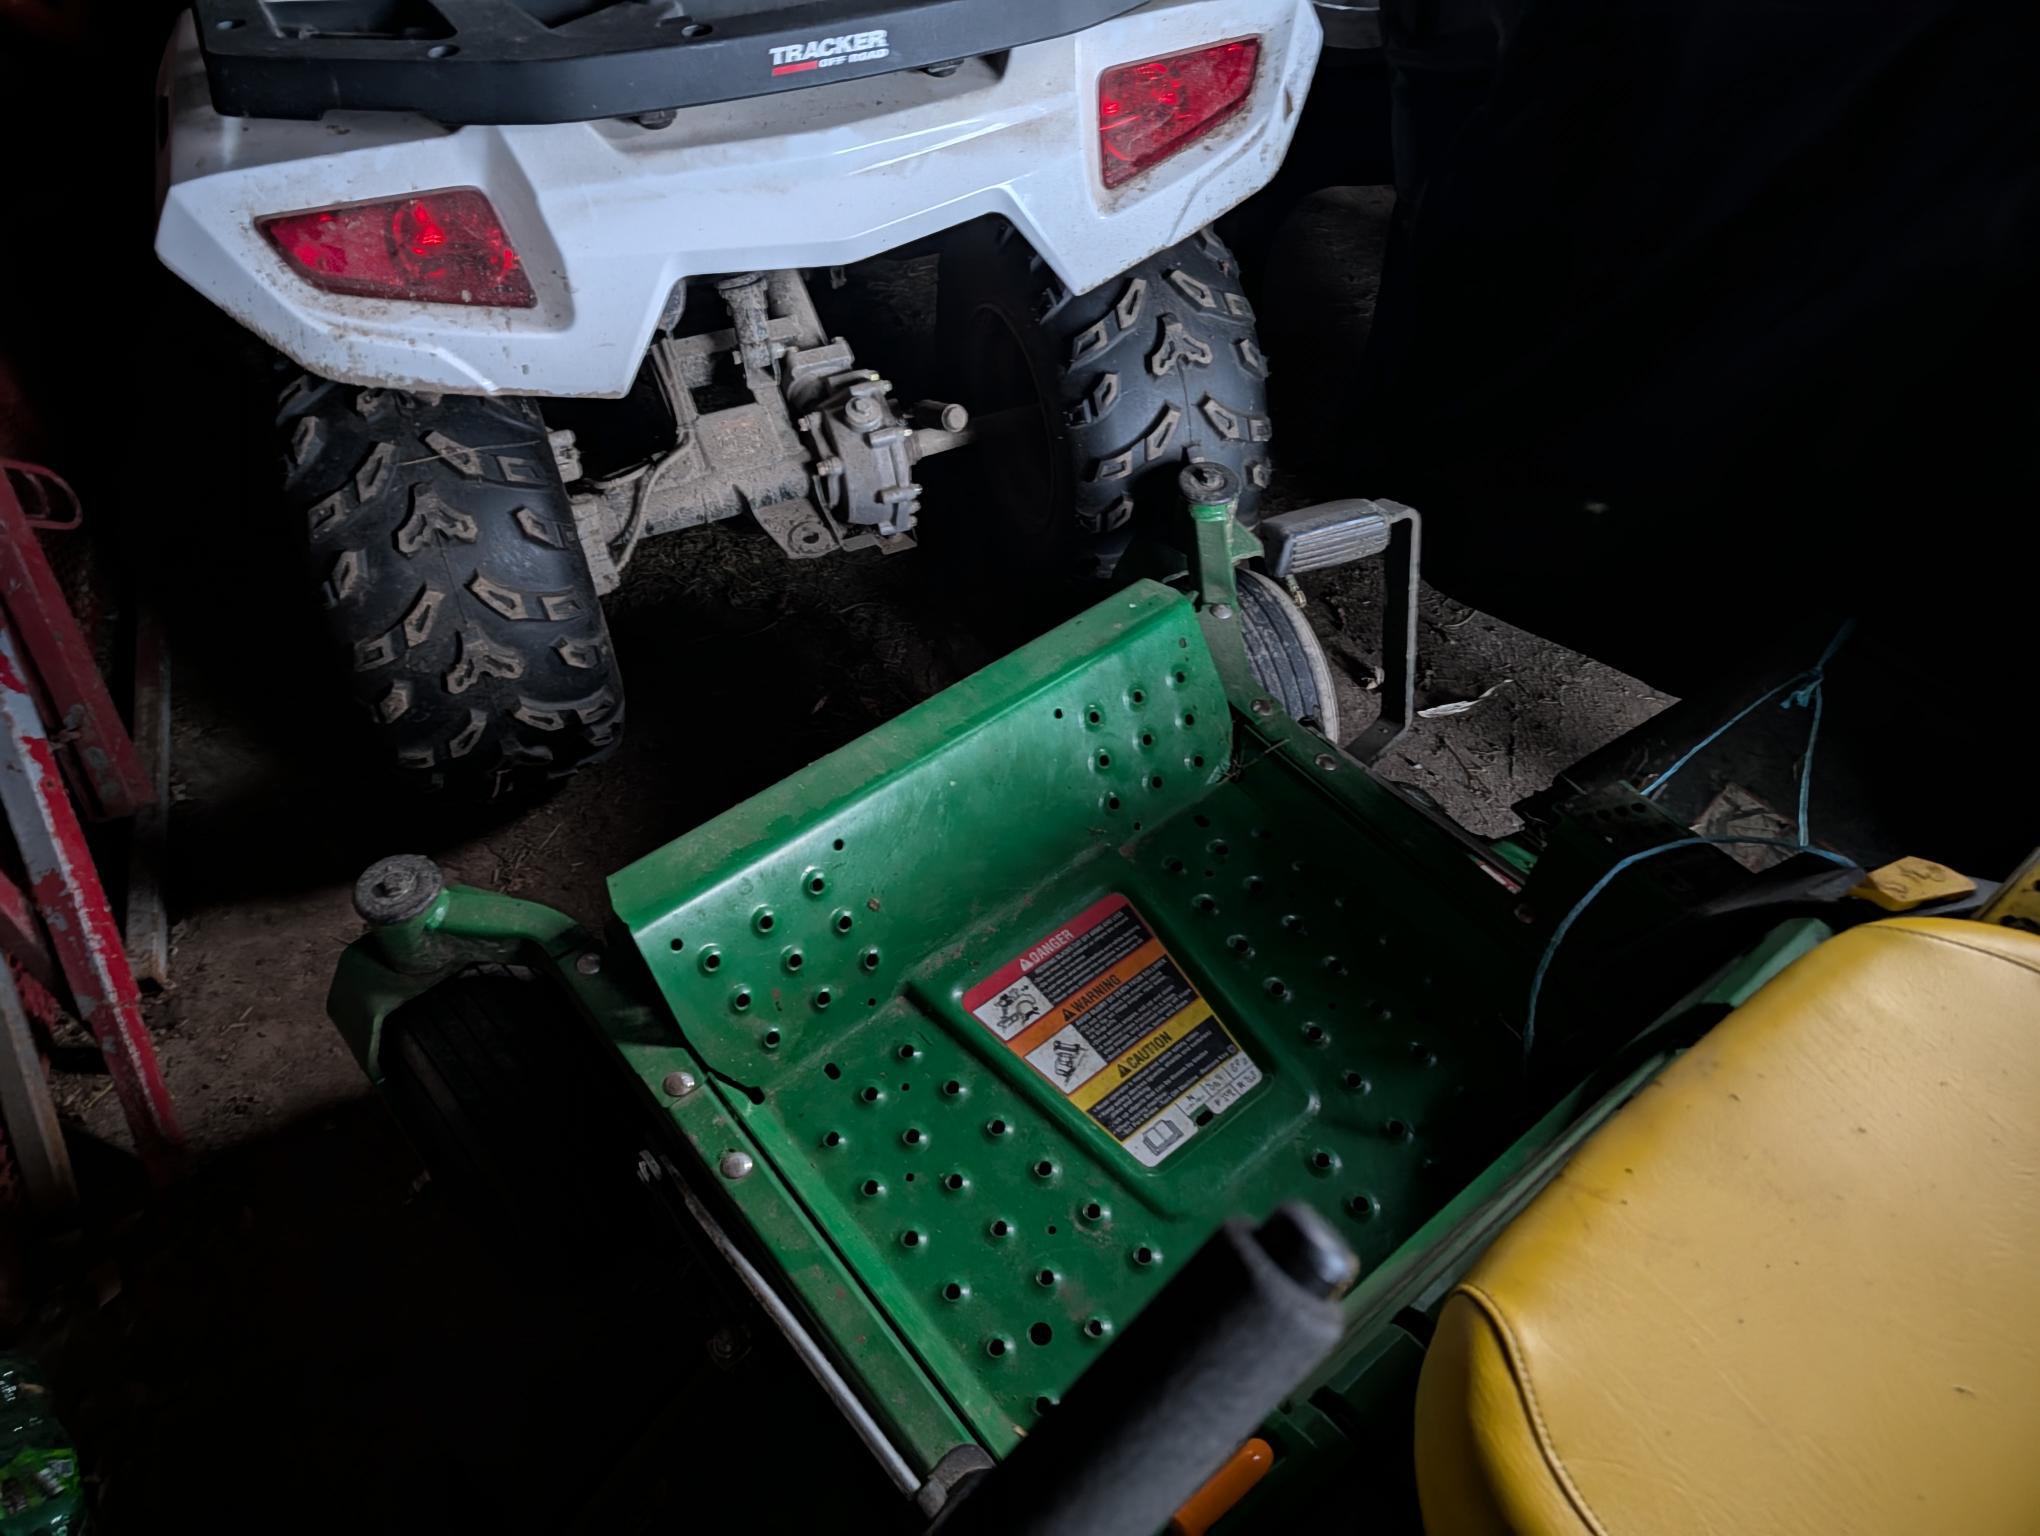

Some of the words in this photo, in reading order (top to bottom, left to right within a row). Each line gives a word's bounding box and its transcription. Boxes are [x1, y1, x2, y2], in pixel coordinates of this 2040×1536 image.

[768, 30, 889, 65] TRACKER
[1029, 929, 1075, 964] DANGER
[1071, 974, 1121, 1014] WARNING
[1127, 1031, 1173, 1069] CAUTION
